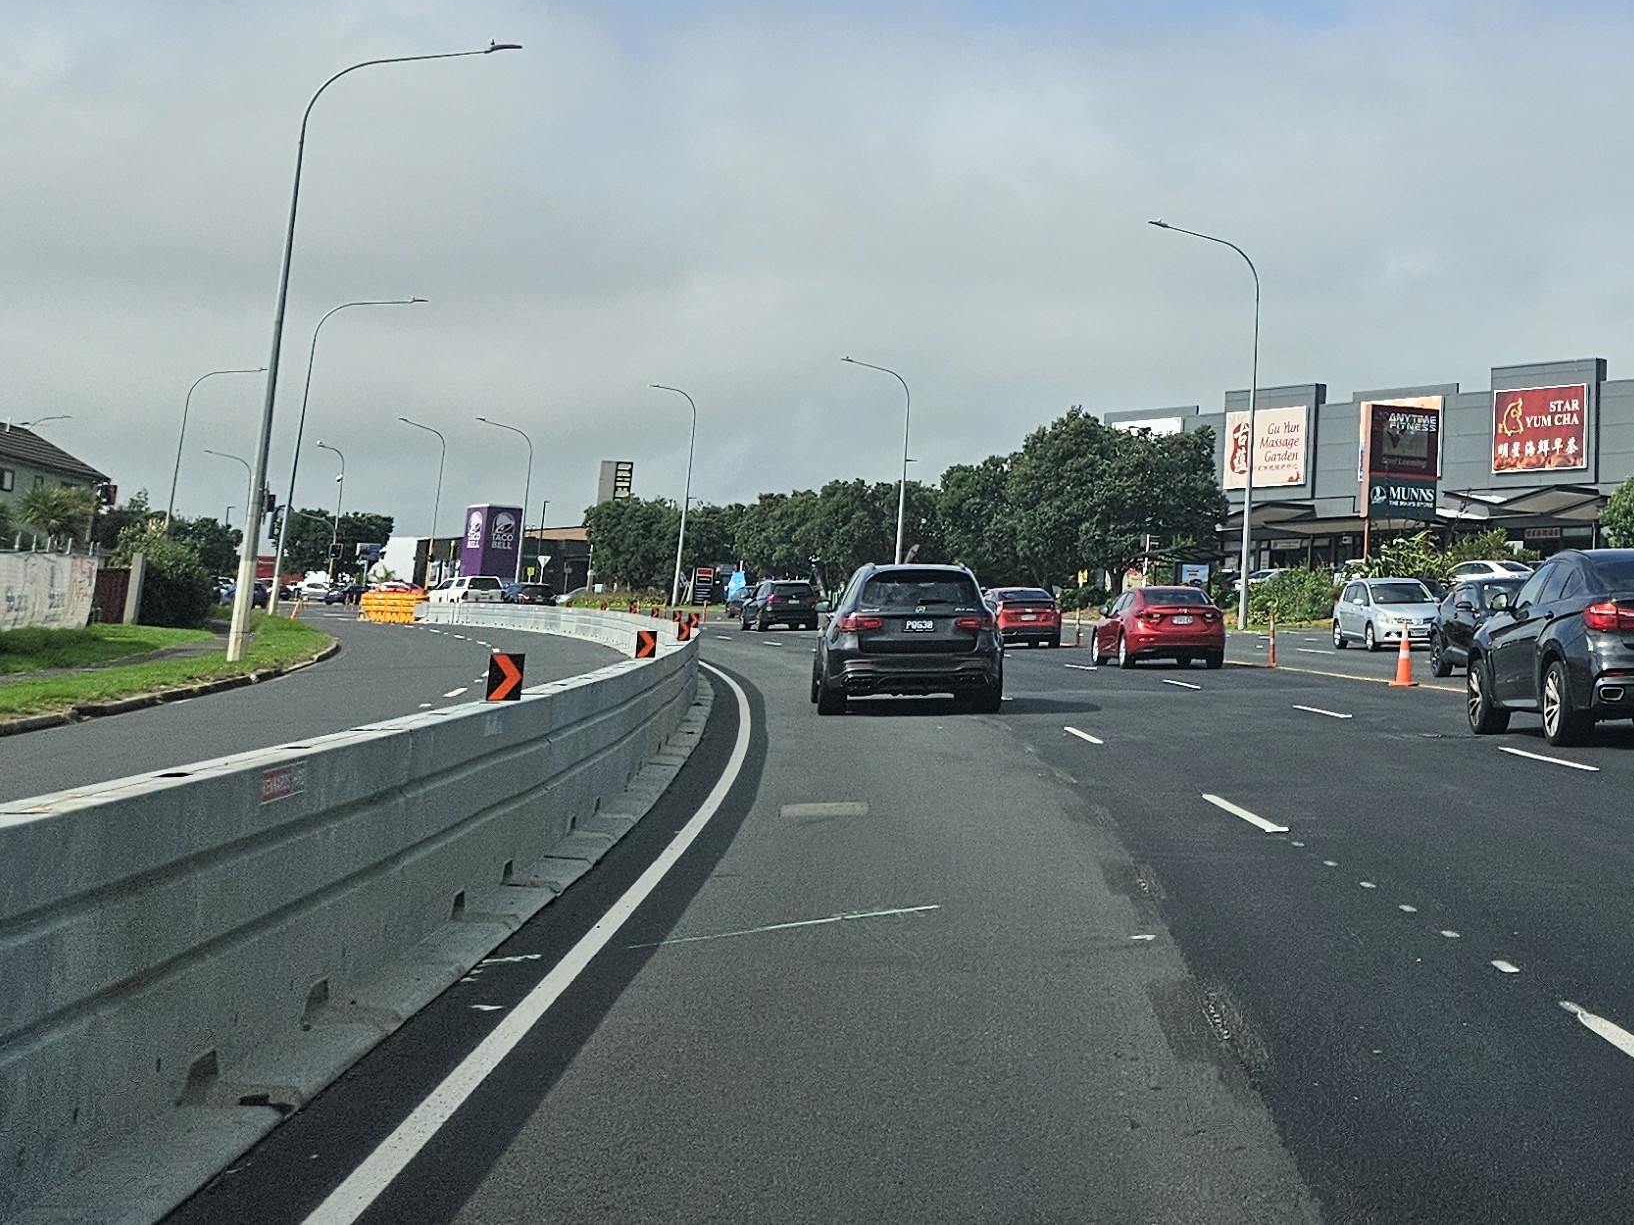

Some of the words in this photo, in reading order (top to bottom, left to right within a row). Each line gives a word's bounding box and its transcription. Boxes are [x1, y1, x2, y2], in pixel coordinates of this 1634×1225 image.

[1549, 399, 1580, 412] STAR
[1388, 412, 1437, 424] ANYTIME
[1525, 415, 1552, 427] YUM
[1554, 413, 1579, 426] CHA
[1267, 422, 1281, 435] Gu
[1284, 421, 1300, 434] Yun
[1389, 422, 1437, 432] FITNESS
[1260, 436, 1300, 450] Massage
[1264, 450, 1299, 463] Garden
[1389, 486, 1435, 502] MUNNS
[491, 533, 514, 542] TACO
[491, 540, 512, 549] BELL
